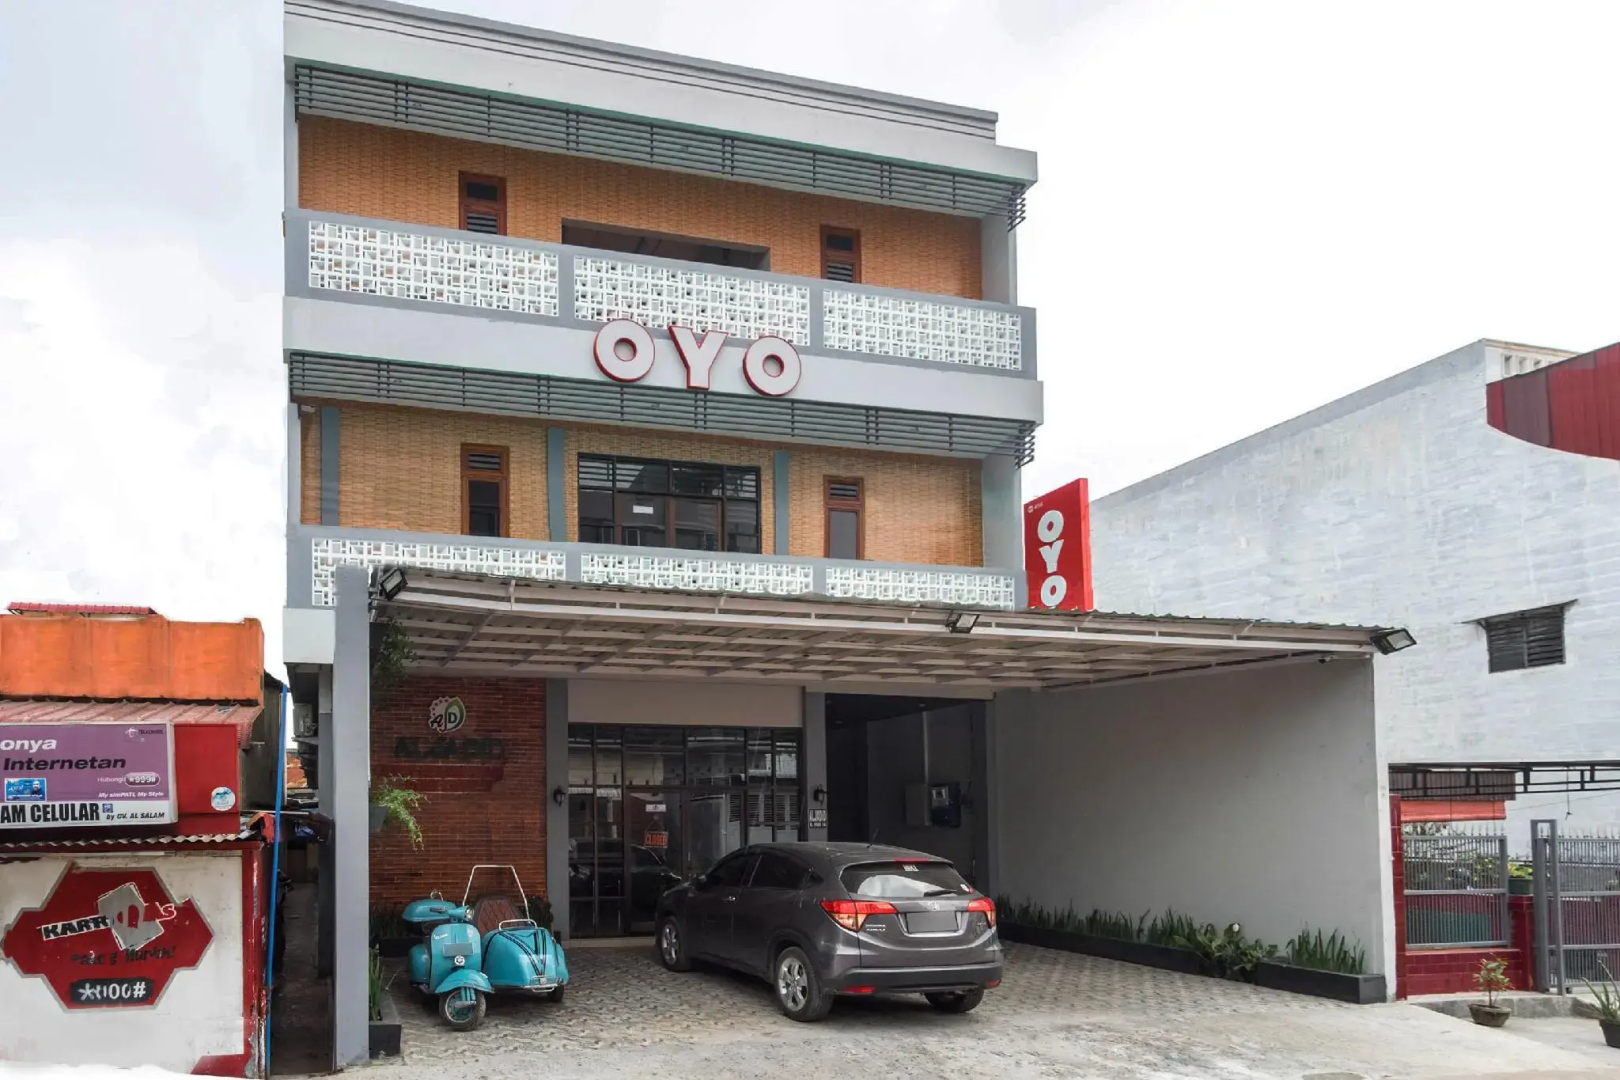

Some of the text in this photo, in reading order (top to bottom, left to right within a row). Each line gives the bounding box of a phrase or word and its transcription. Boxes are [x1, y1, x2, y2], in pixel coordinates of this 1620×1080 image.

[593, 318, 802, 397] OYO
[1037, 509, 1067, 607] OYO
[0, 738, 58, 753] onya
[3, 757, 126, 771] Internetan
[0, 803, 100, 823] AM CELULAR
[140, 811, 165, 819] SALAM
